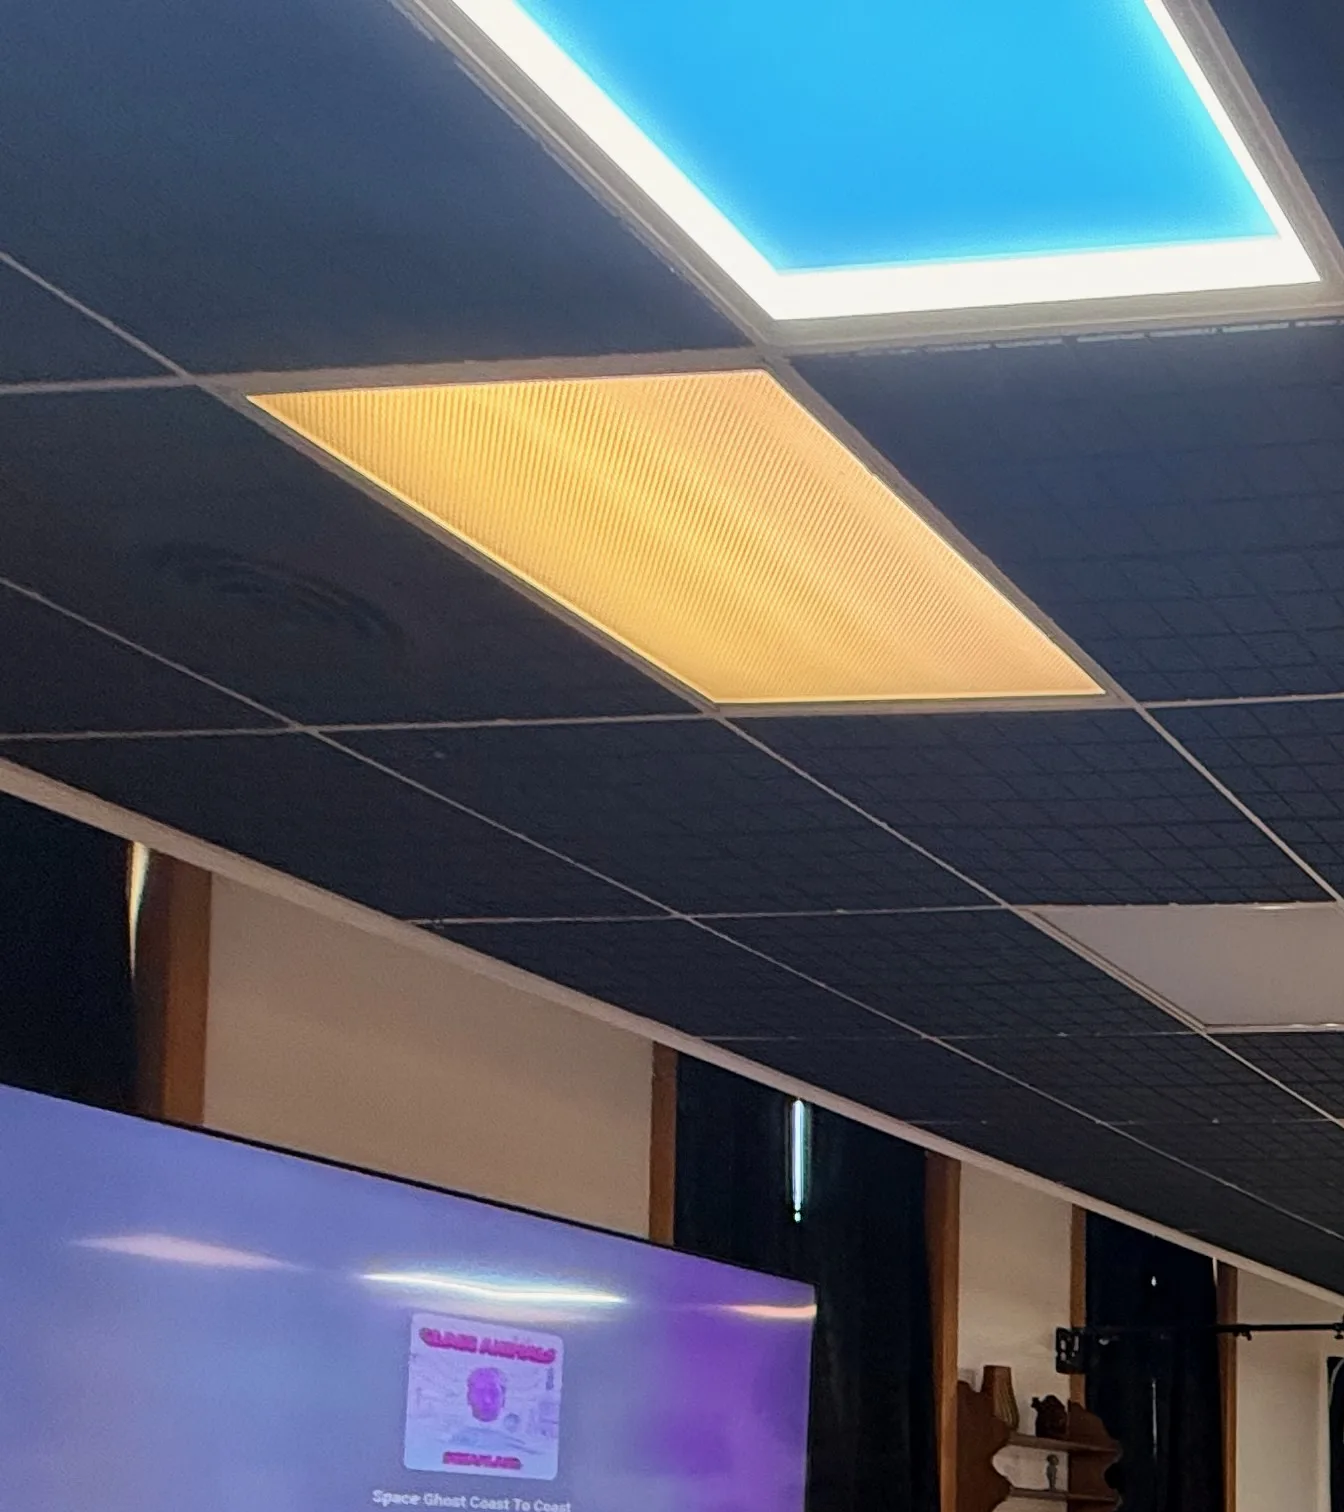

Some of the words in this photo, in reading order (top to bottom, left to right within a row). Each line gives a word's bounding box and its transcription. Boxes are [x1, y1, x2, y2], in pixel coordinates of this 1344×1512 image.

[372, 1489, 421, 1507] Space
[423, 1492, 467, 1508] Ghost
[469, 1495, 510, 1511] Coast
[513, 1497, 531, 1512] To
